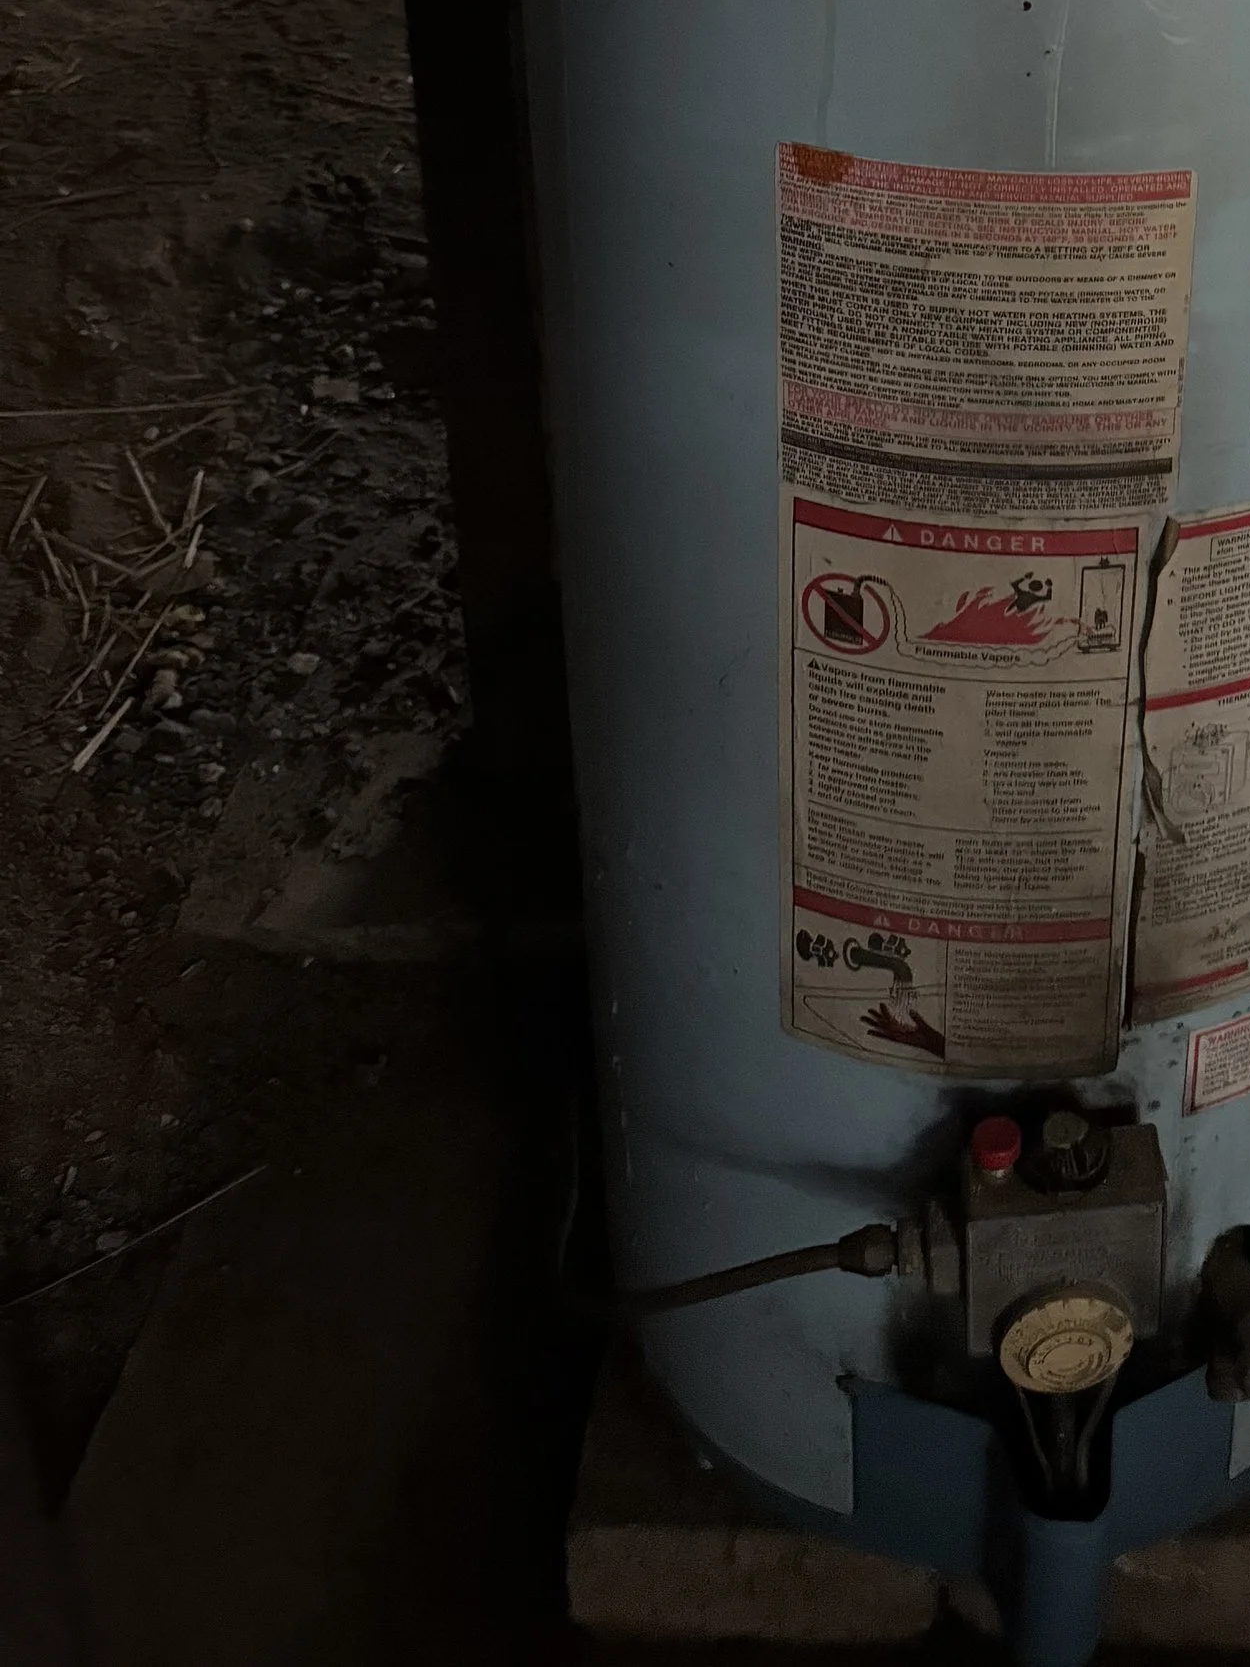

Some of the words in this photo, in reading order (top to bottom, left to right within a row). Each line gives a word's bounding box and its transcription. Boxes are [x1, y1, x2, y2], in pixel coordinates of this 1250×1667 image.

[920, 529, 1047, 552] DANGER
[915, 646, 979, 661] Flammable
[981, 650, 1021, 664] Vapors
[808, 669, 842, 688] liquids
[845, 679, 863, 691] will
[865, 683, 909, 701] explode
[911, 691, 932, 703] and
[821, 662, 857, 683] Vapors
[860, 671, 885, 685] from
[888, 676, 946, 694] flammable
[858, 693, 901, 711] causing
[903, 702, 935, 714] death
